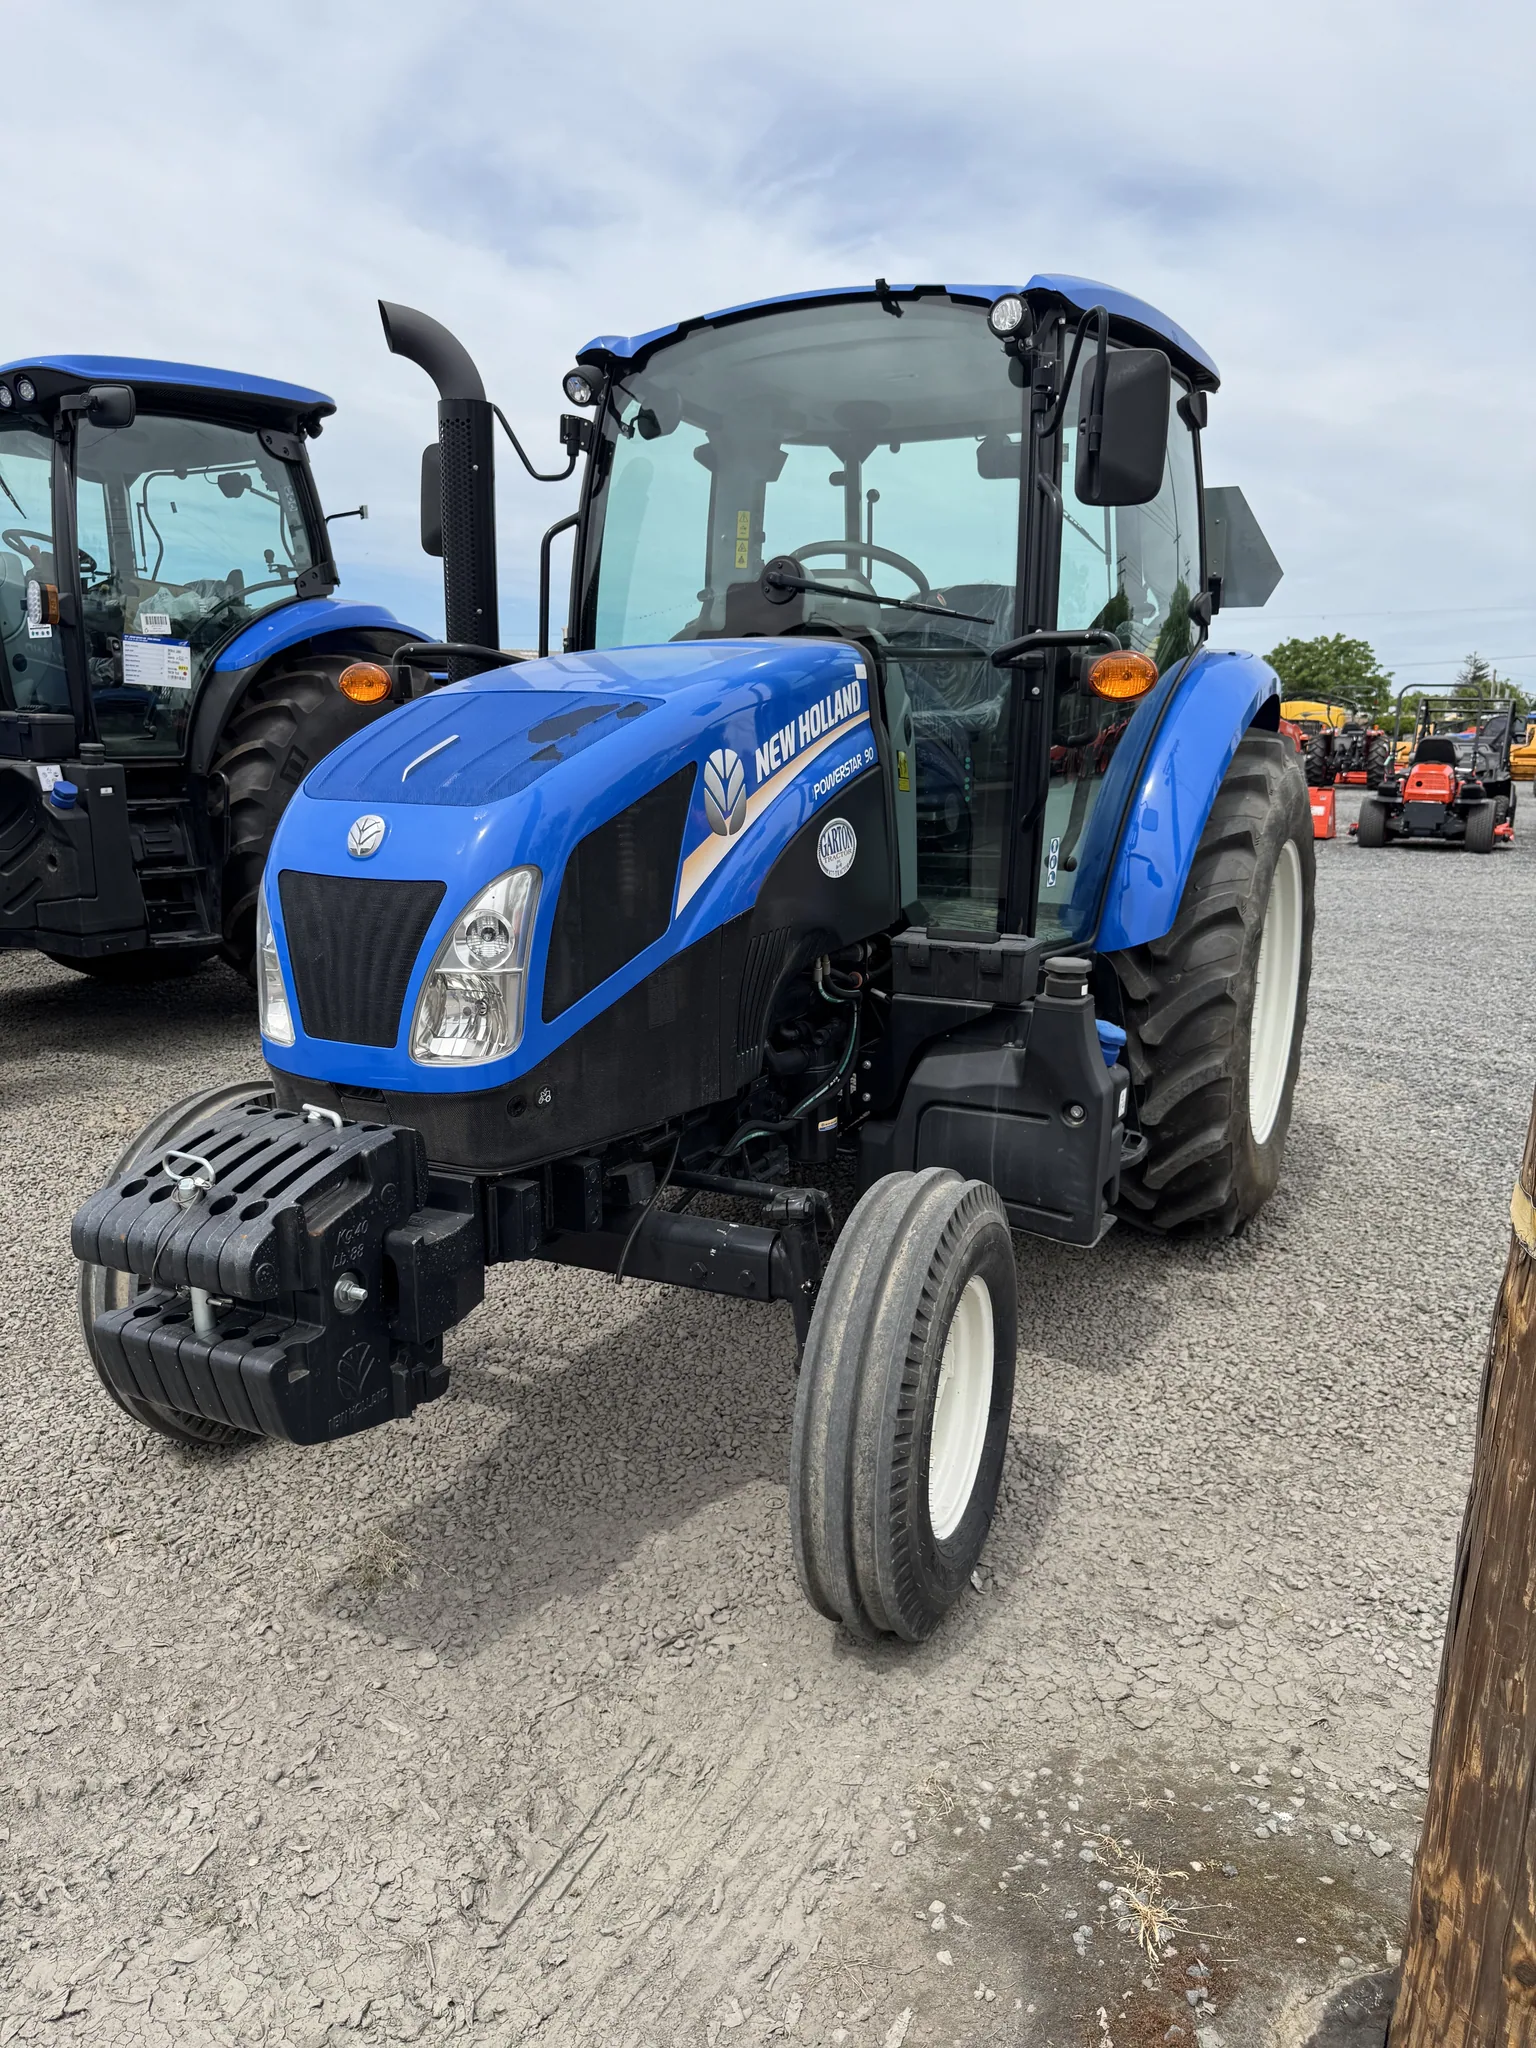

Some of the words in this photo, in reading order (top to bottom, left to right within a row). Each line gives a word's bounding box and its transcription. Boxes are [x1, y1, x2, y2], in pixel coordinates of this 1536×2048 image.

[755, 720, 795, 783] NEW
[798, 680, 861, 748] HOLLAND
[813, 757, 862, 800] POWERSTAR
[865, 747, 874, 765] 90
[820, 825, 853, 858] GARTON
[823, 848, 852, 864] TRACTOR
